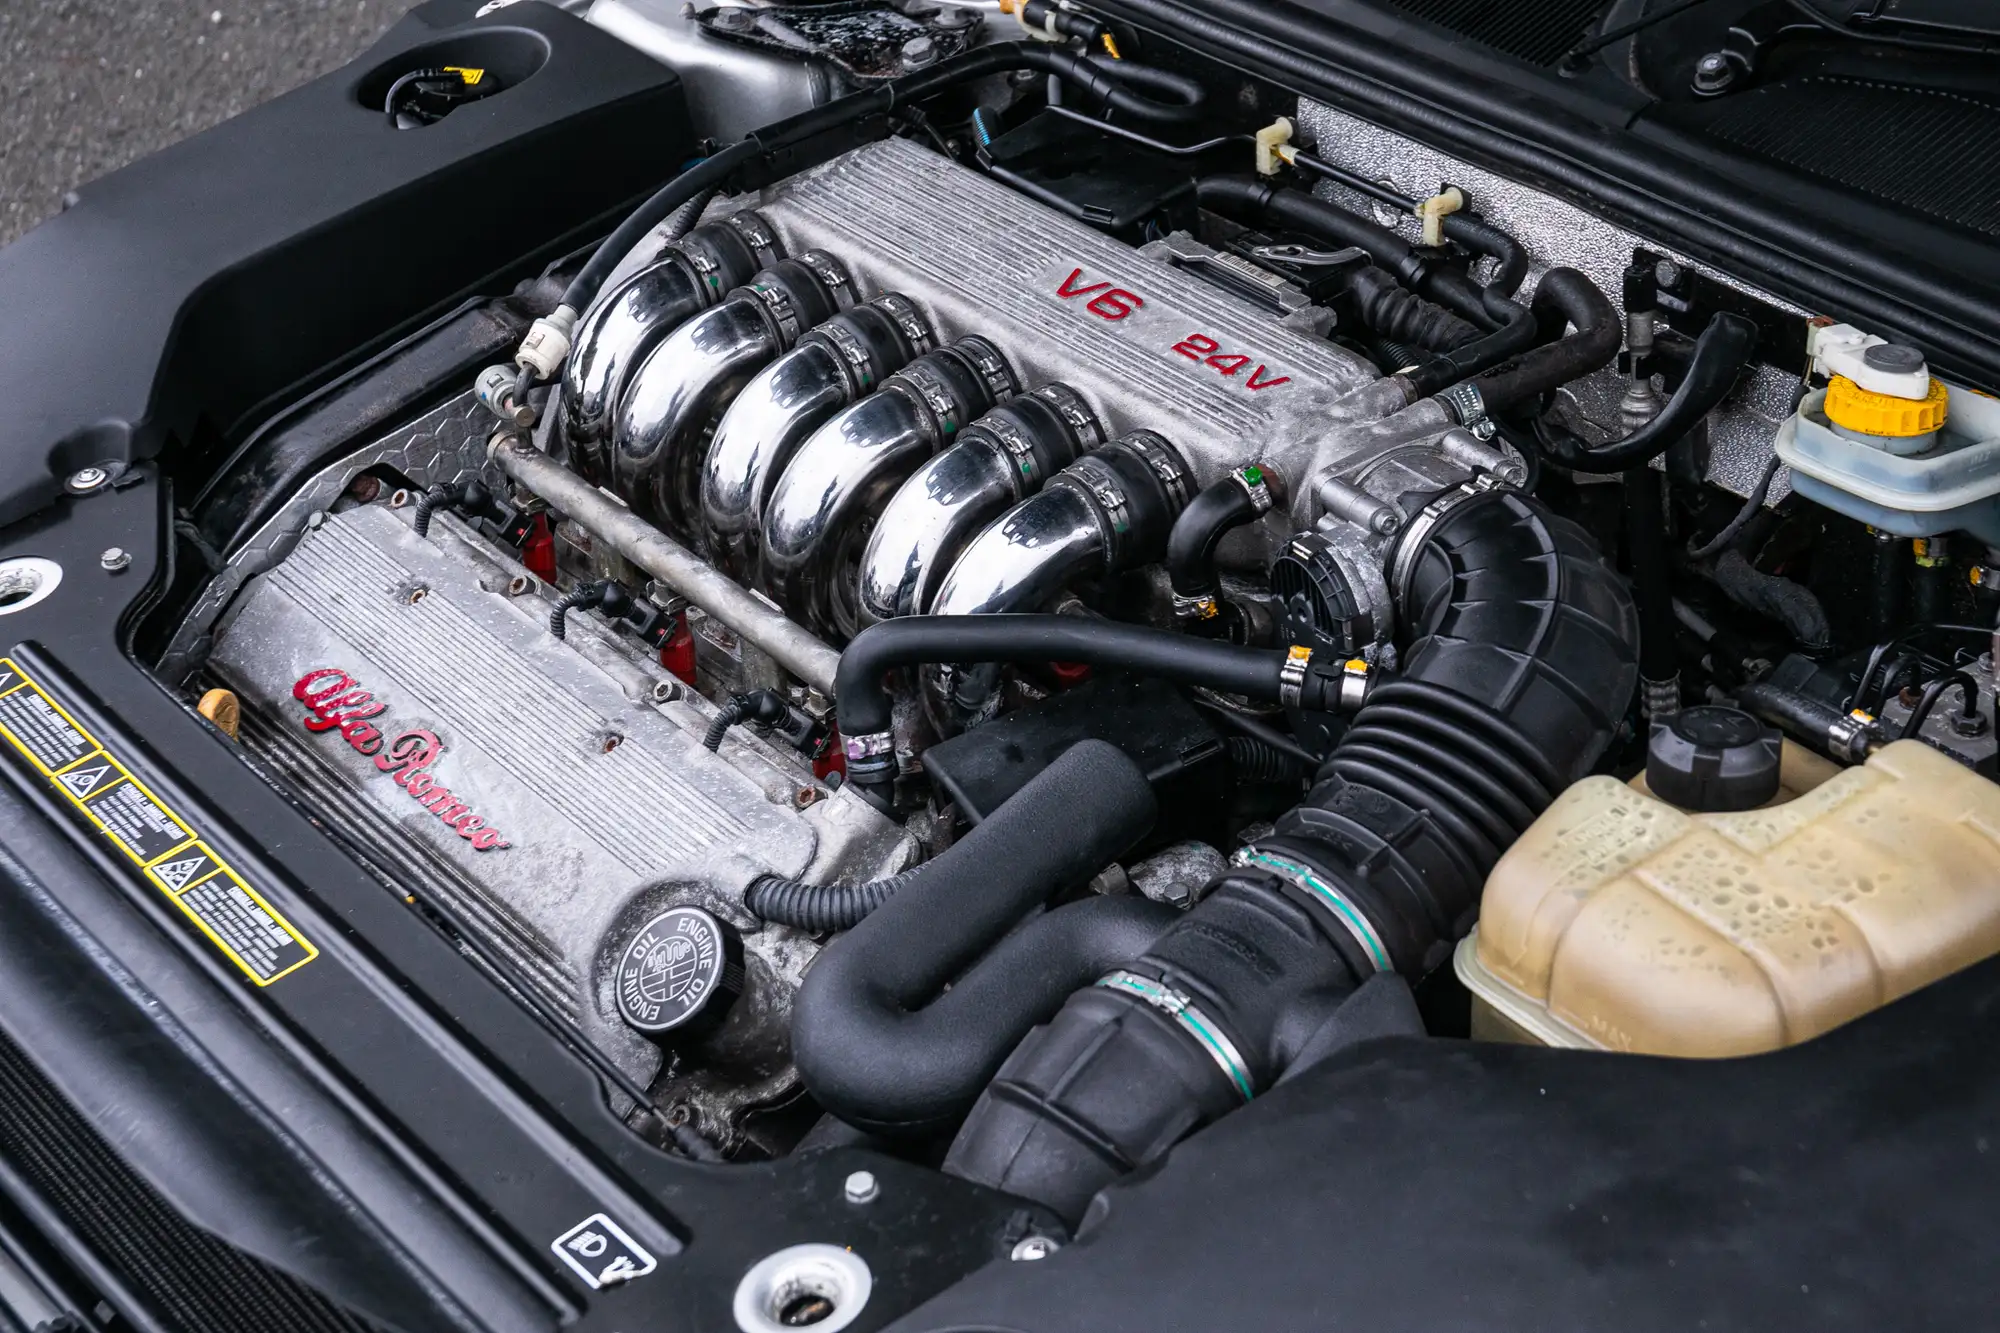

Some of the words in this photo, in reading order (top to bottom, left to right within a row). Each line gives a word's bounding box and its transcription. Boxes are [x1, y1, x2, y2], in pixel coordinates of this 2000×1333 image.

[1056, 267, 1144, 321] V6
[1171, 333, 1291, 391] 24V
[293, 668, 385, 756] Alfa
[374, 729, 511, 850] Romeo
[632, 932, 660, 960] OIL
[676, 917, 714, 970] ENGINE
[624, 967, 661, 1021] ENGINE
[678, 978, 705, 1007] OIL
